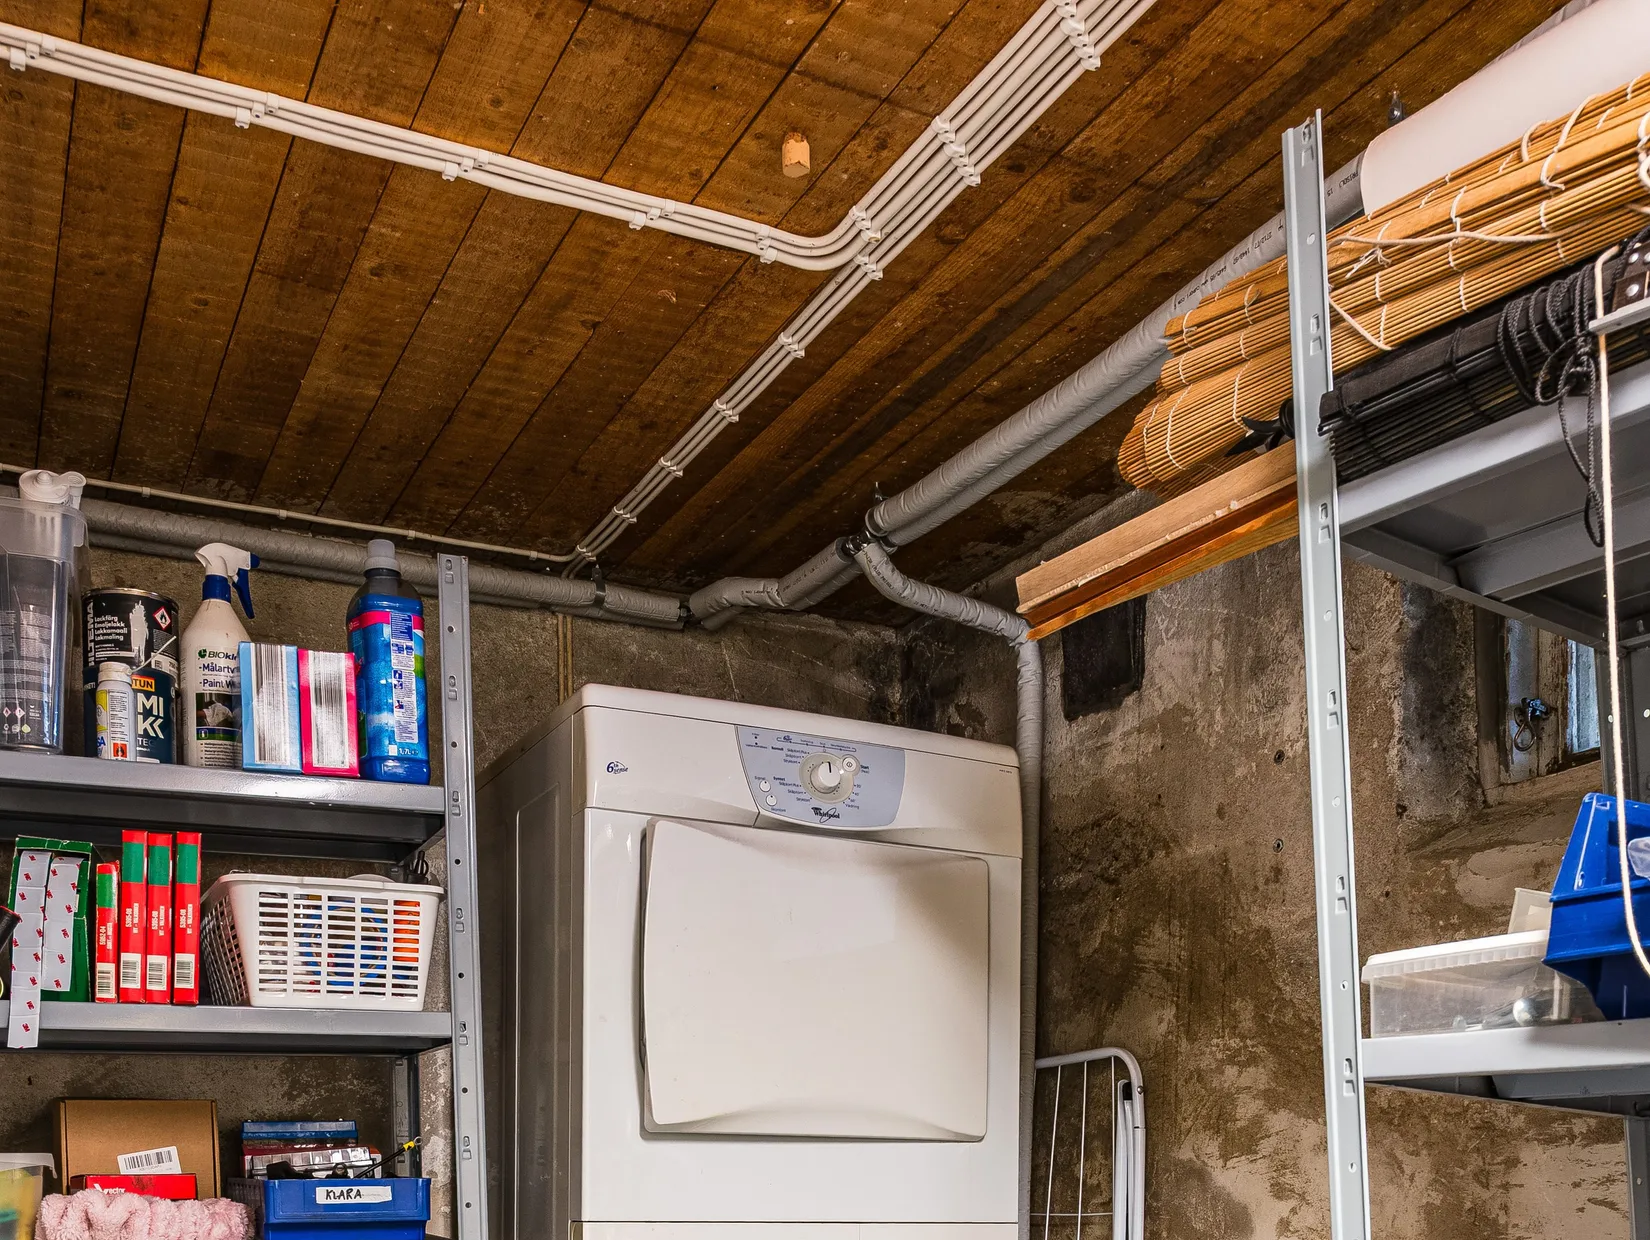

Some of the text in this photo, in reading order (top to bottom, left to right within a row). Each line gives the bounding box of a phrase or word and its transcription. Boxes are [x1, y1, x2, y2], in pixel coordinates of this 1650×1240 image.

[132, 679, 153, 689] TUN
[137, 692, 164, 717] MI
[811, 807, 840, 821] Whirlpool
